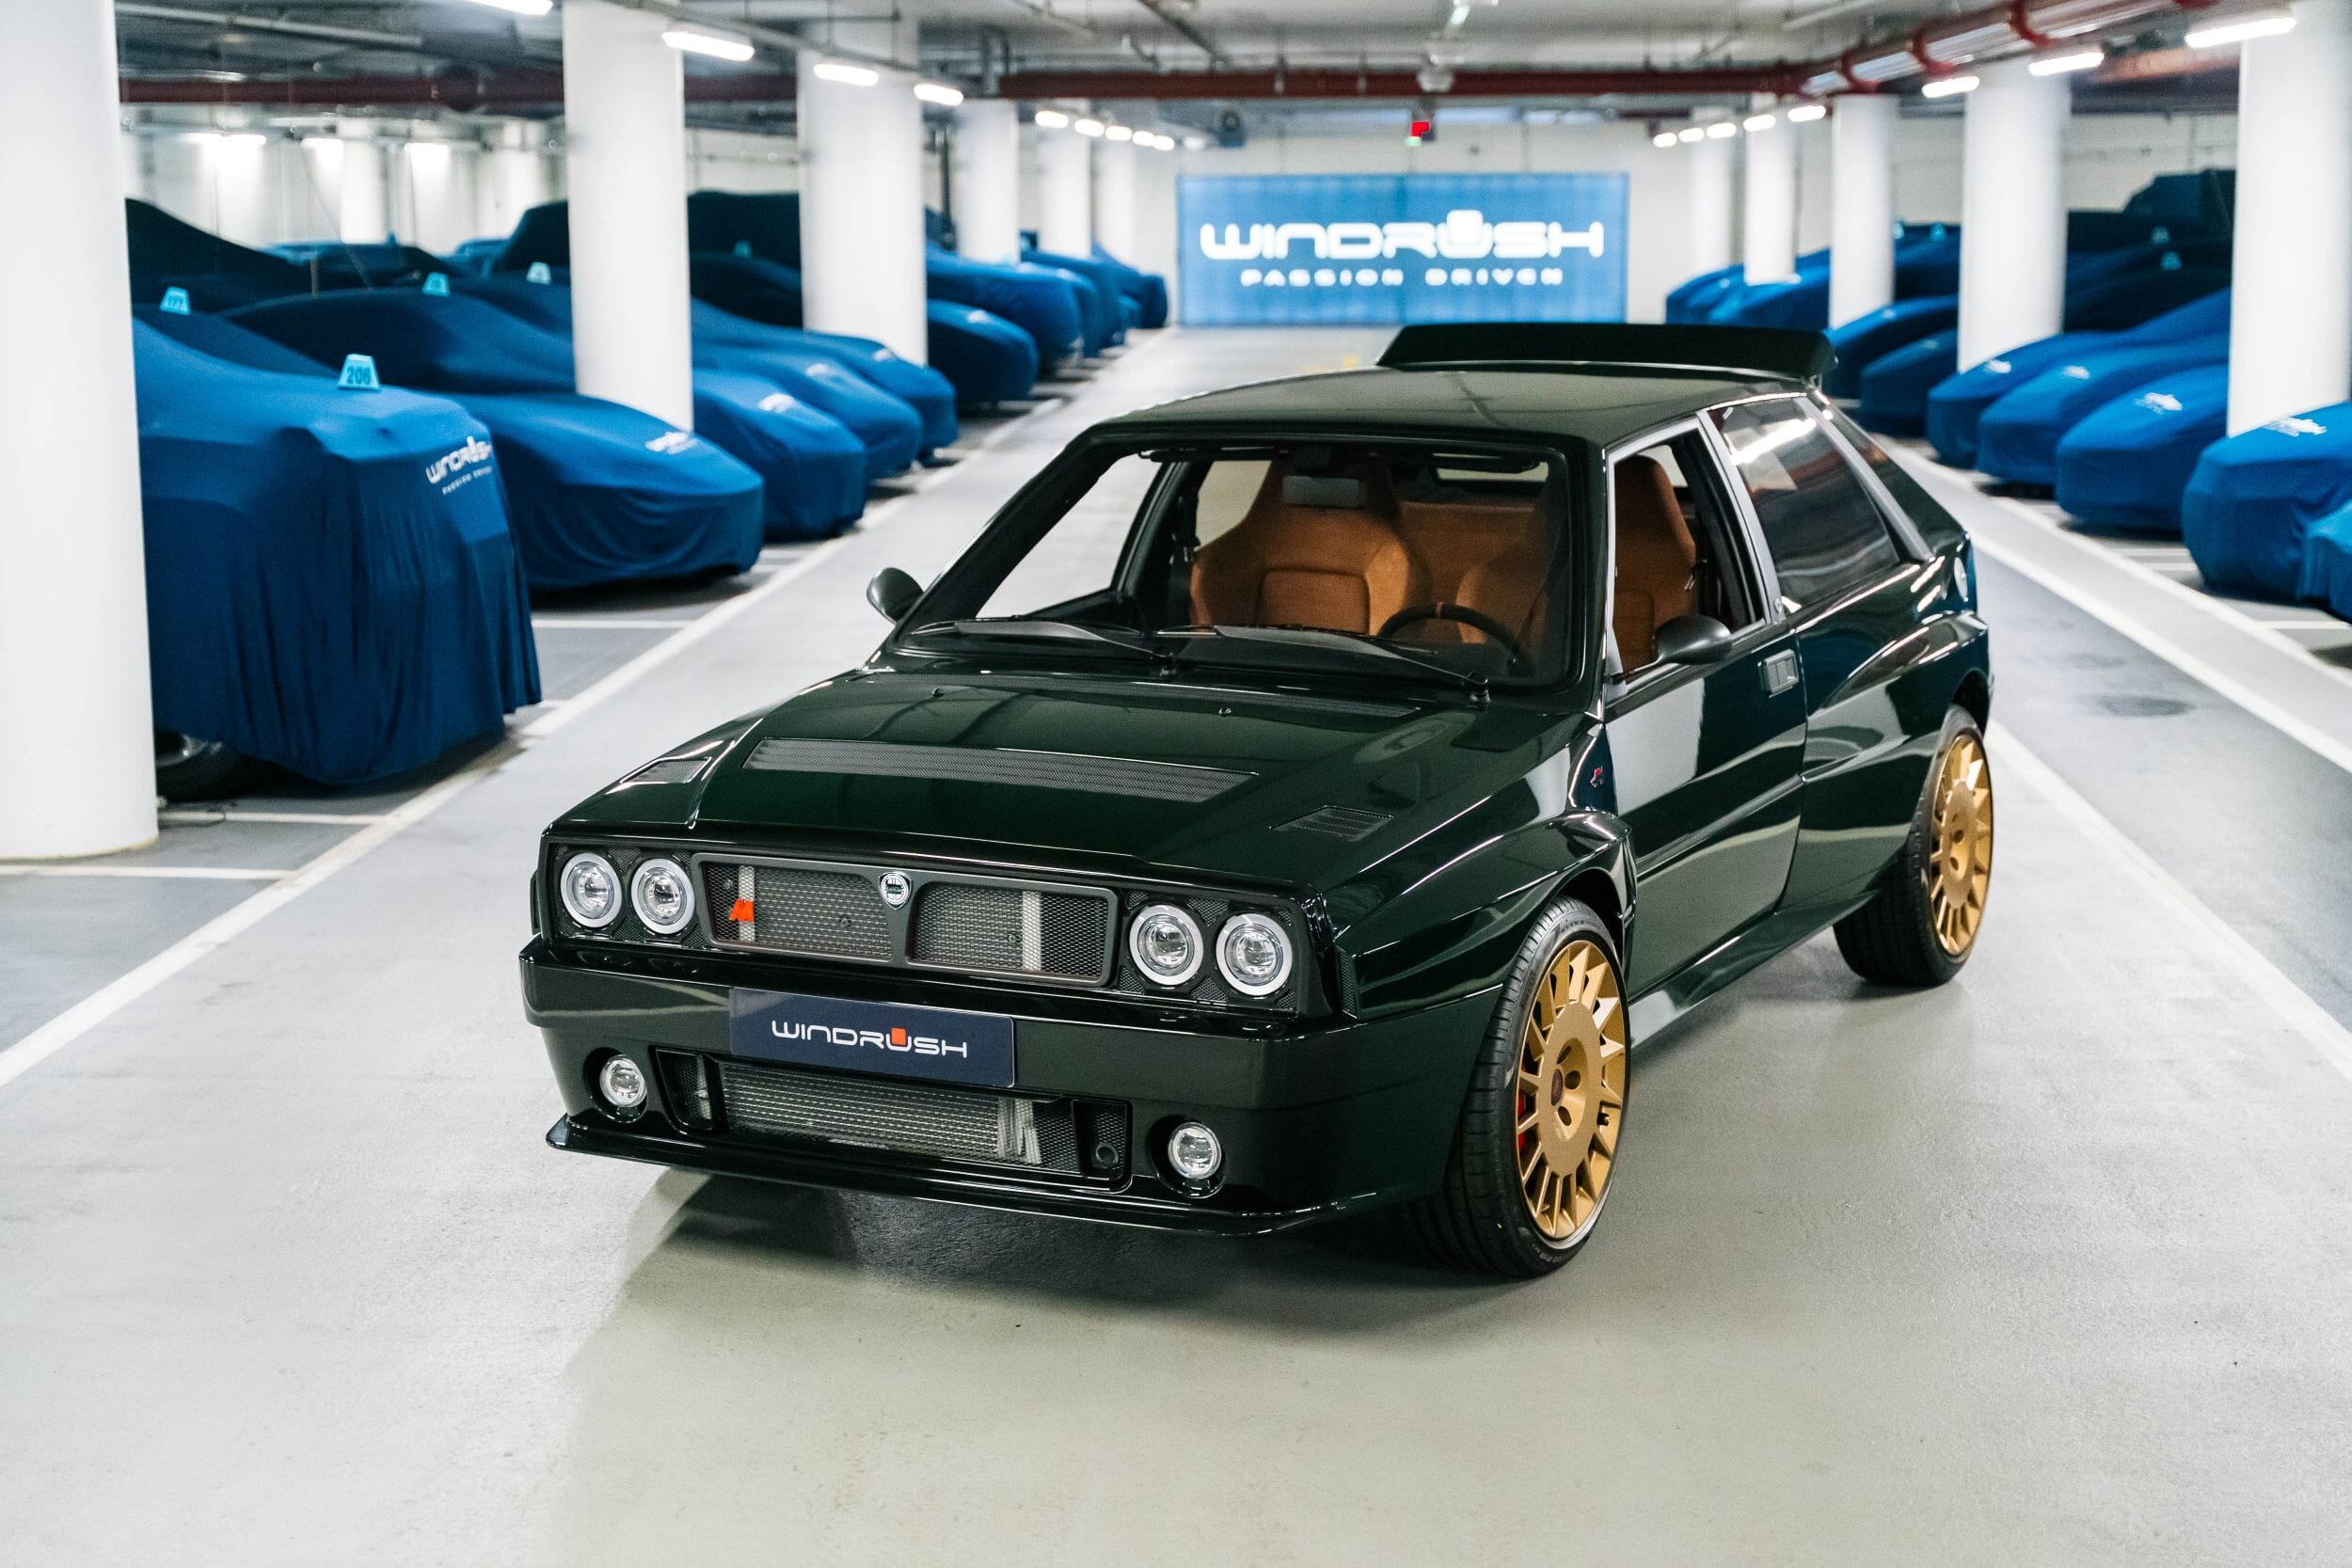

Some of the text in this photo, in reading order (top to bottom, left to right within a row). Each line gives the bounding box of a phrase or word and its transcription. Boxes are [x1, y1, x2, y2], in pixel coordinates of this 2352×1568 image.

[1200, 210, 1604, 260] WINDRUSH
[1240, 267, 1564, 286] PASSION DRIVEN
[346, 365, 372, 386] 206
[771, 1020, 967, 1058] WINDRUSH
